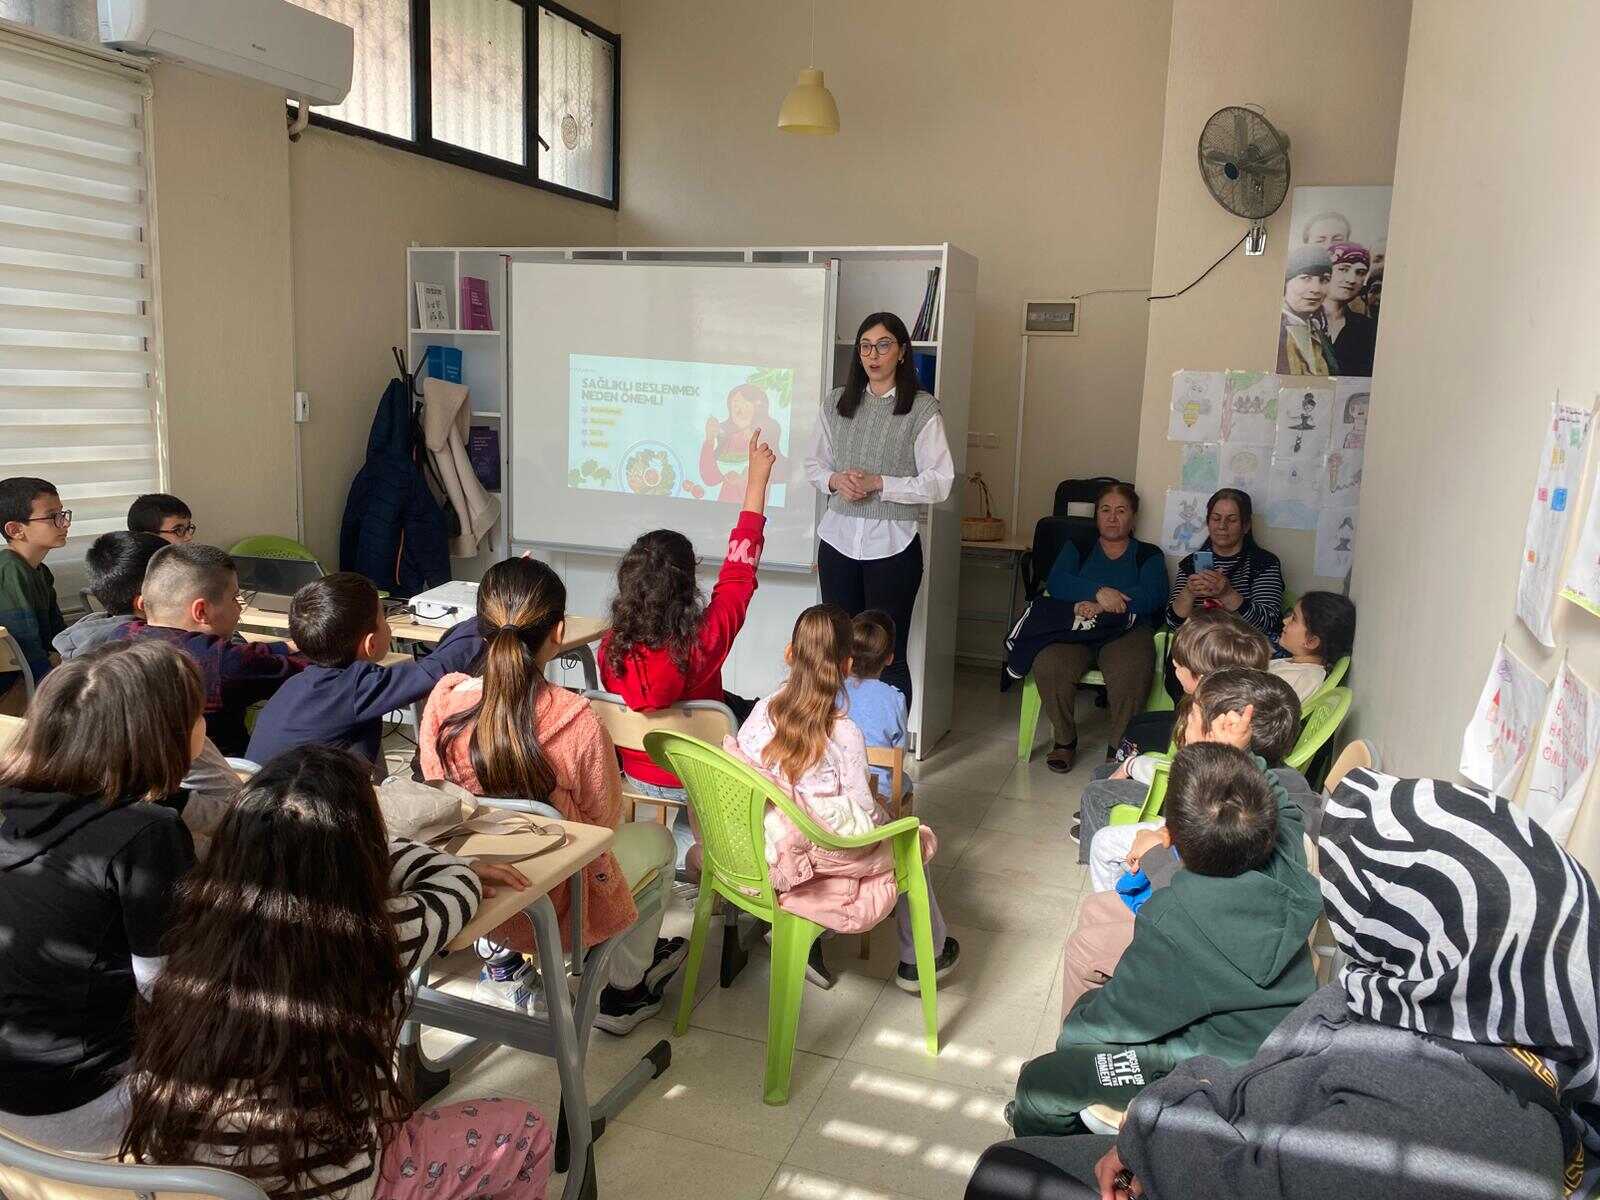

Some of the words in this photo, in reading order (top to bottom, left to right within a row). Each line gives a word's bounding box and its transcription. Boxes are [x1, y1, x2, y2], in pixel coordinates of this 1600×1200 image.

[581, 390, 618, 402] NEDEN
[582, 377, 633, 391] SAĞLIKLI
[635, 383, 700, 396] BESLENMEK
[1097, 1053, 1112, 1087] MOMENT
